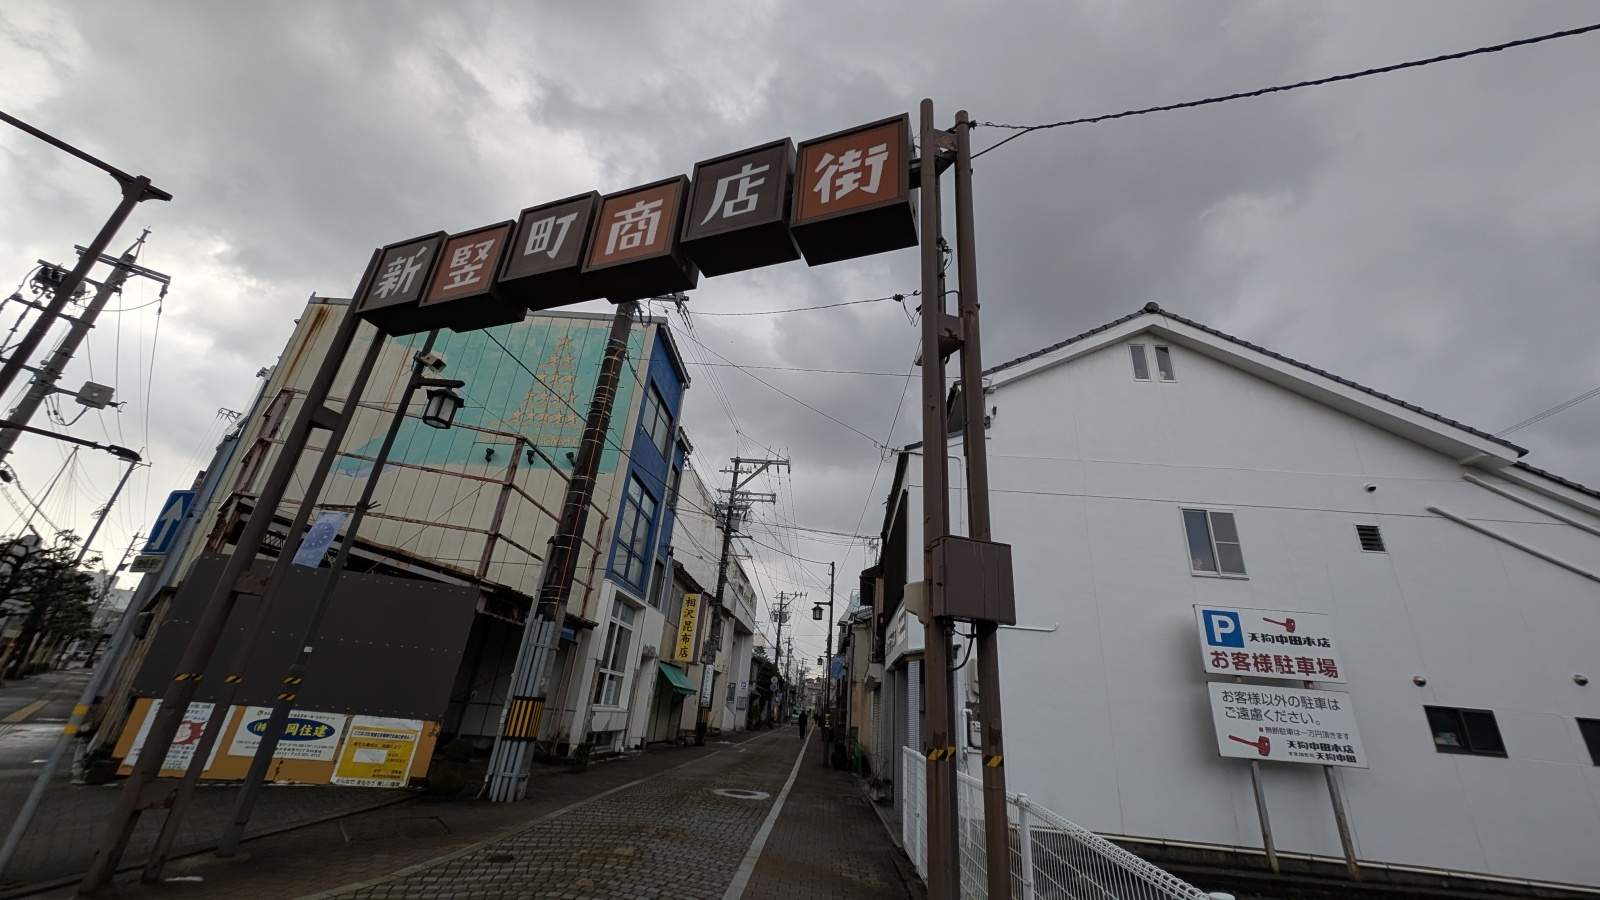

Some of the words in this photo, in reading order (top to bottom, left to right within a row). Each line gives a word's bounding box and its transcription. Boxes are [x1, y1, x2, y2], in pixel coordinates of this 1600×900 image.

[679, 597, 696, 658] 相沢昆布店
[1211, 615, 1235, 643] P
[1247, 632, 1331, 648] 天狗中田本店
[1210, 651, 1339, 678] お客様駐車場
[1222, 690, 1341, 711] お客様以外の駐車は
[1225, 707, 1321, 726] ご遠慮ください。
[1265, 726, 1350, 741] 無断駐車は一万円頂きます
[1287, 740, 1355, 754] 天狗中田本店
[1315, 752, 1357, 764] 天狗中田
